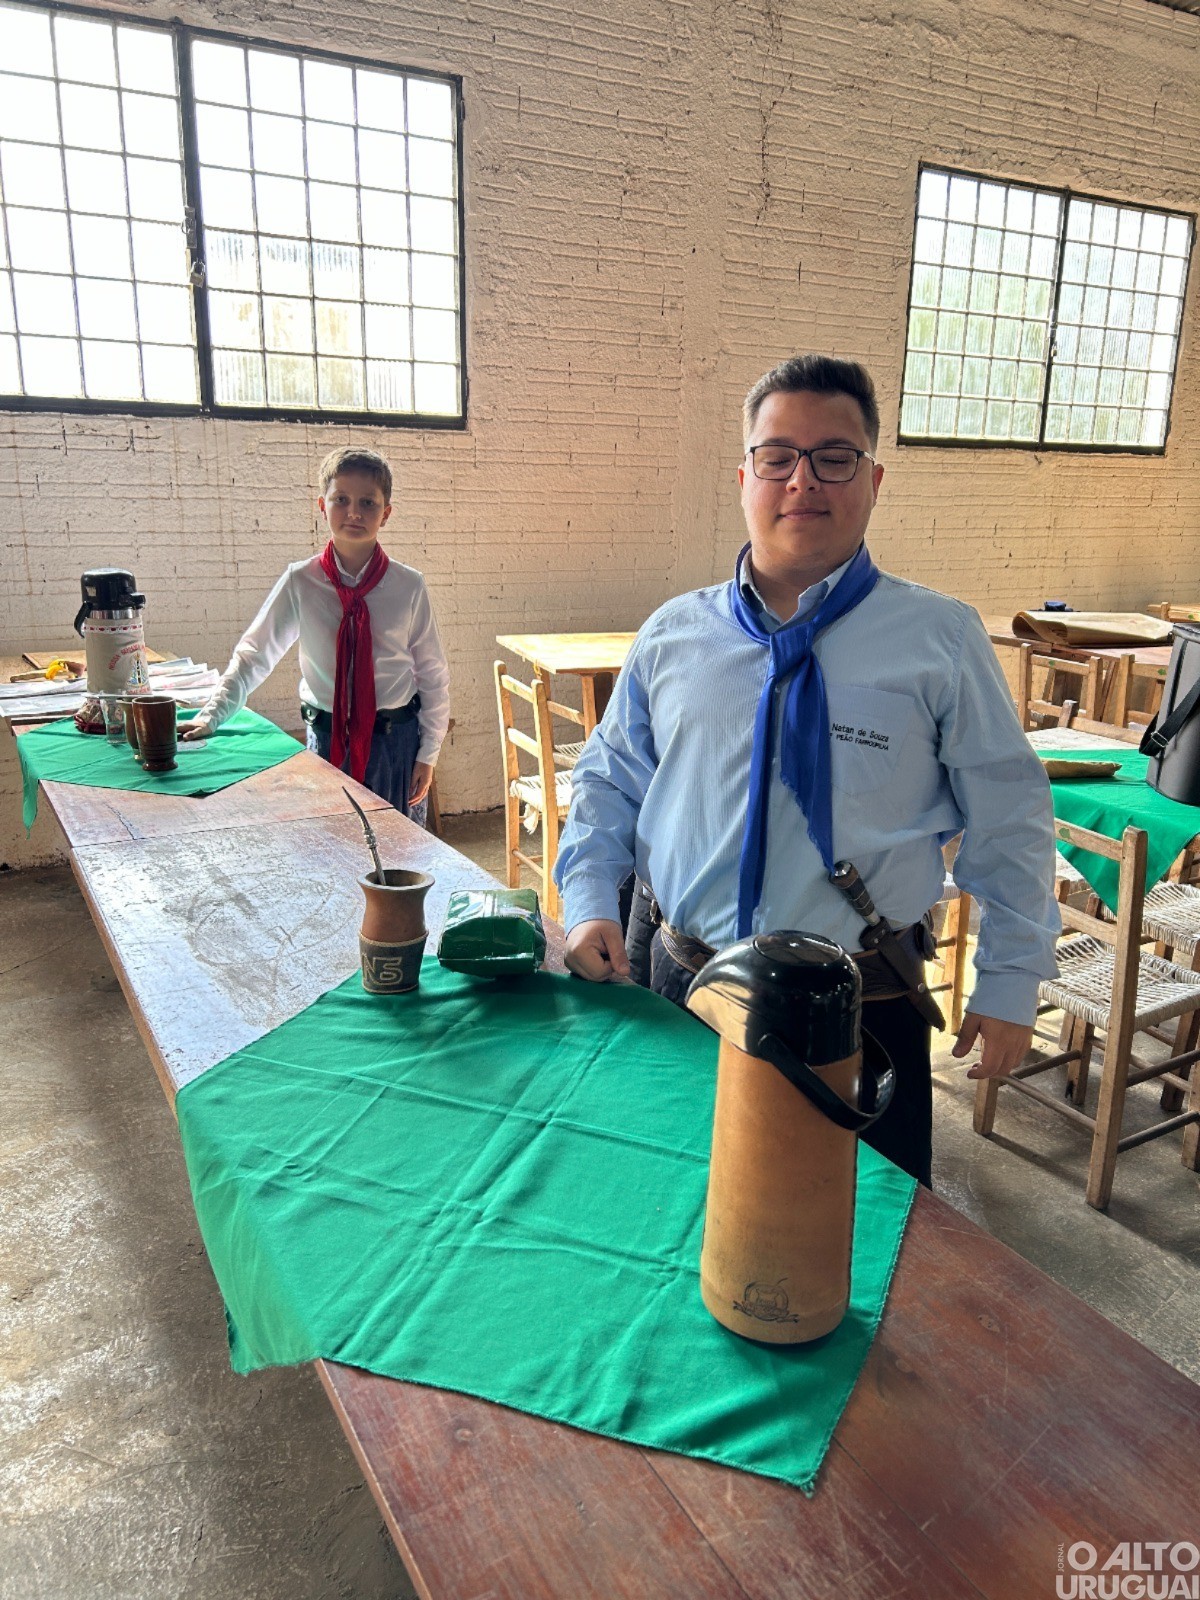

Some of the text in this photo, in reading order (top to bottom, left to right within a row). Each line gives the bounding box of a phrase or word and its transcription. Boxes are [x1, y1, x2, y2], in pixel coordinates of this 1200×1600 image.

[831, 723, 889, 742] Natan de Souza
